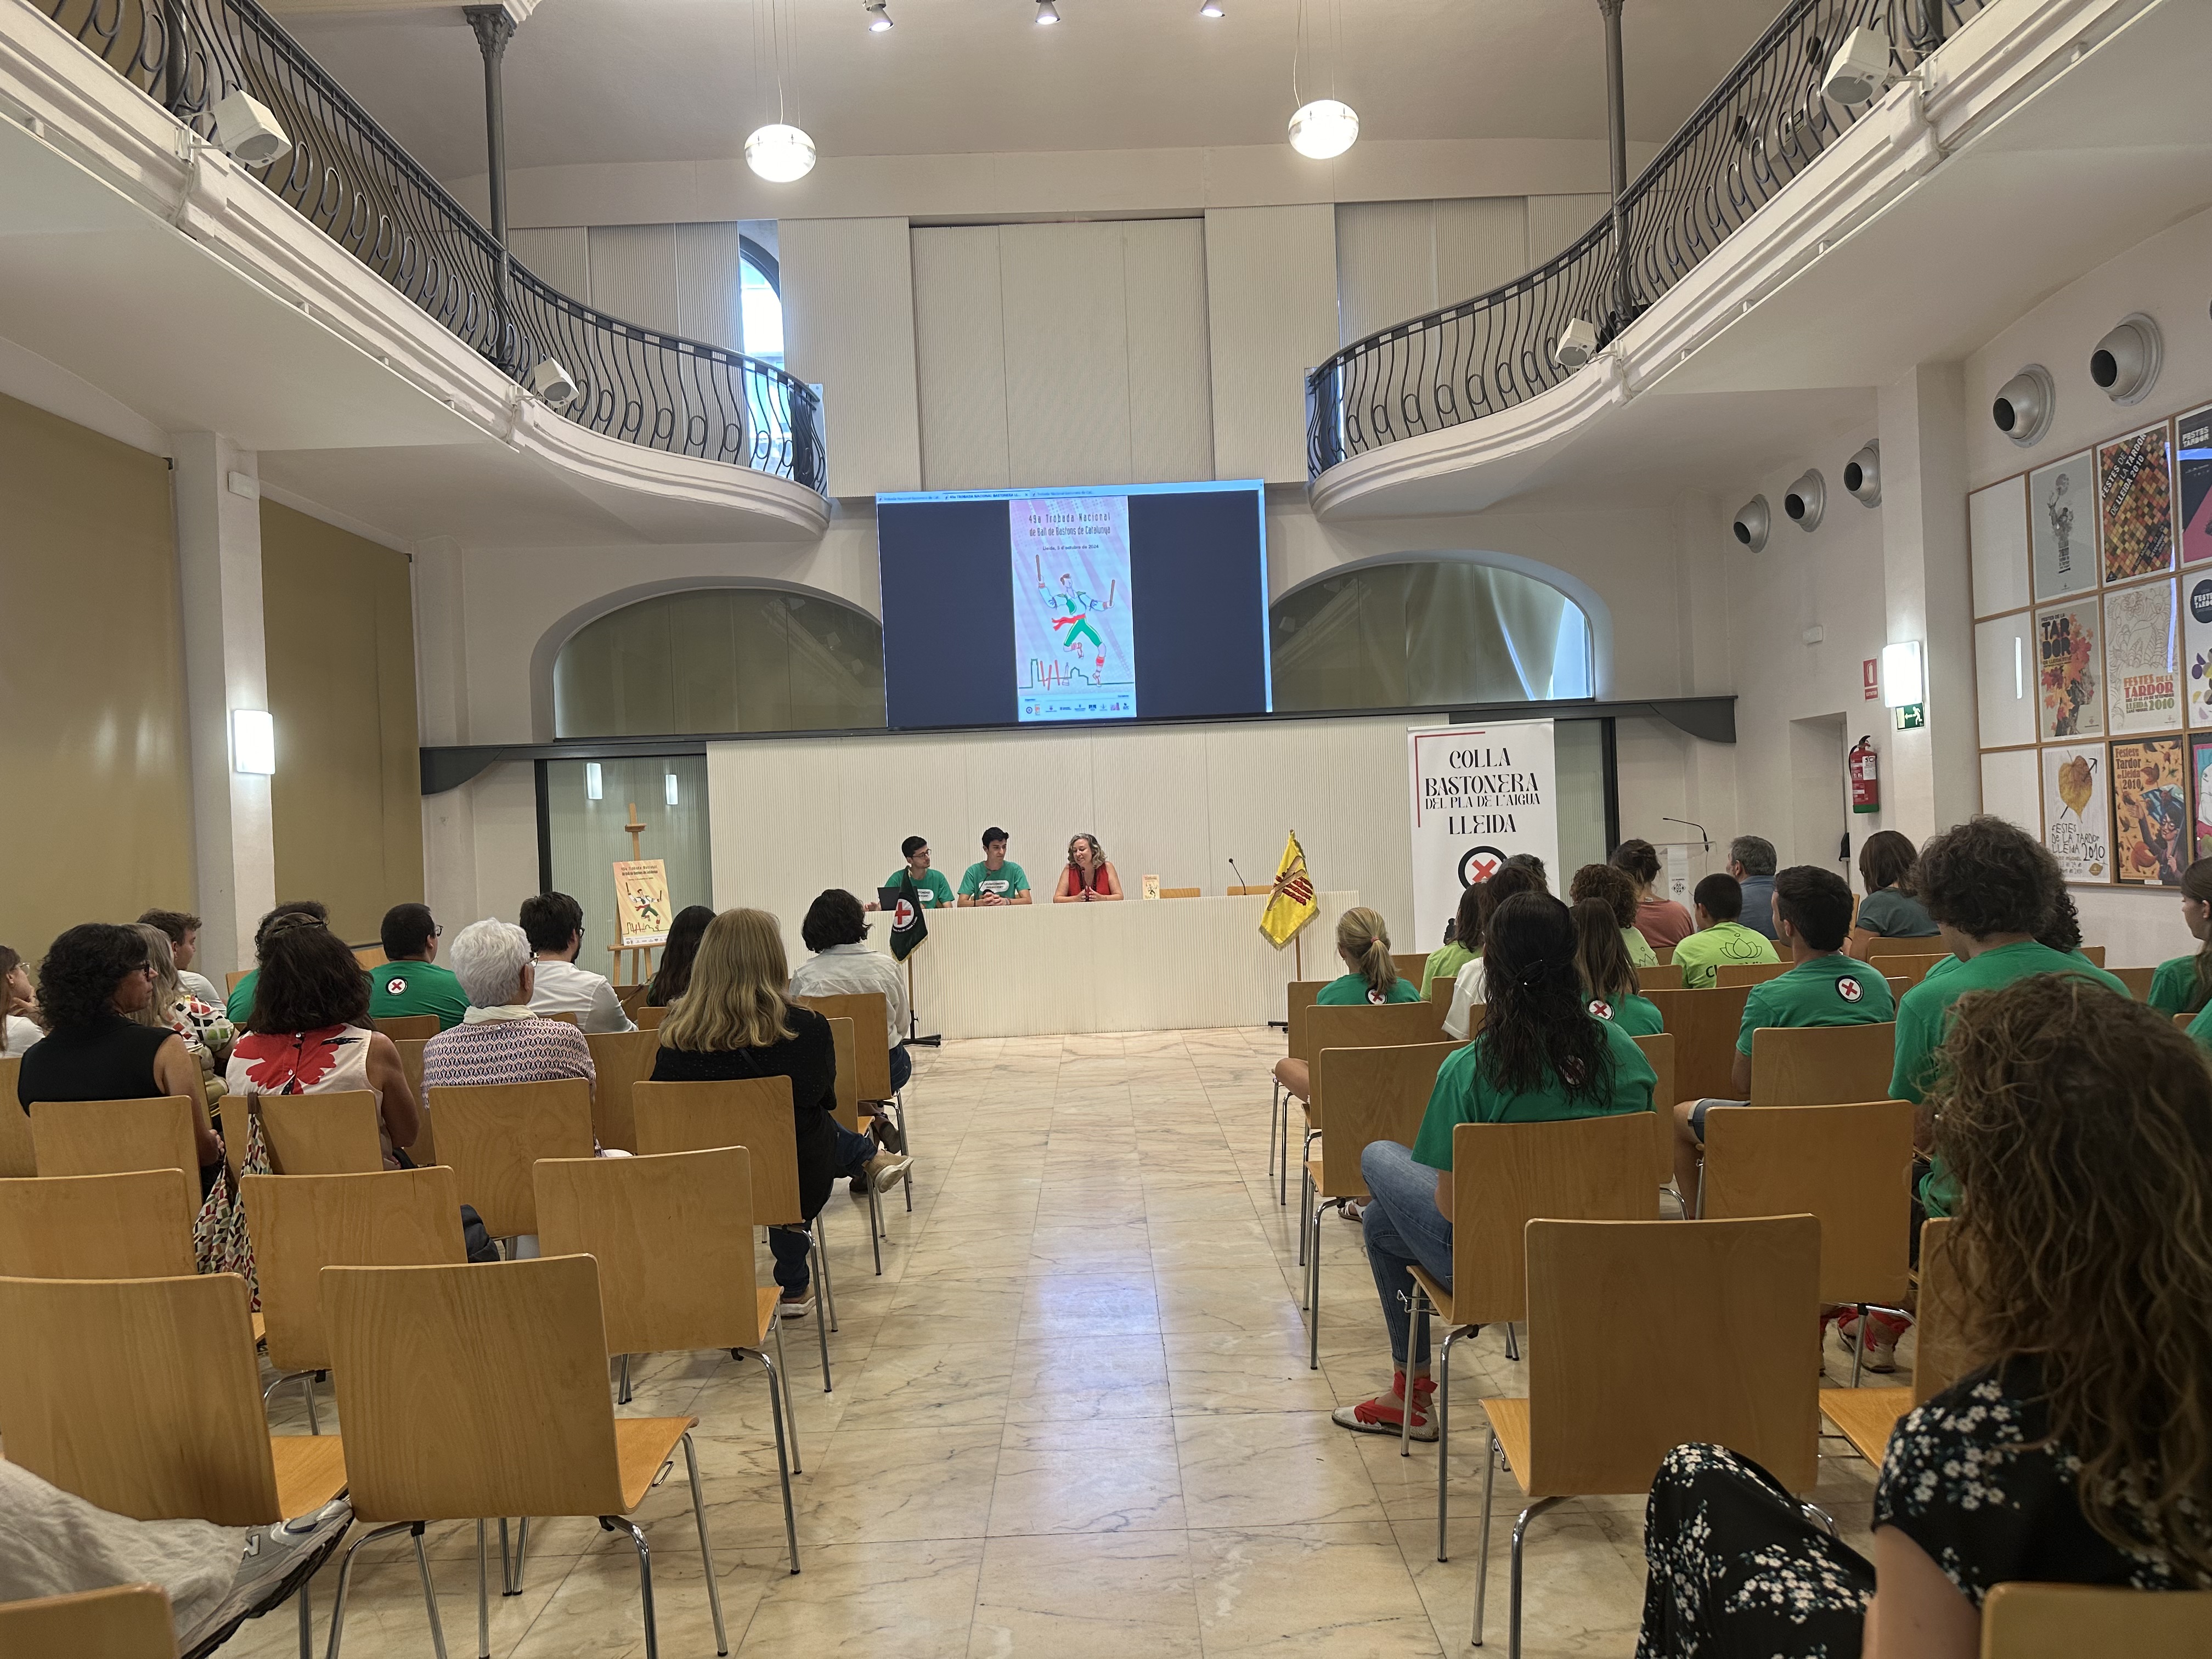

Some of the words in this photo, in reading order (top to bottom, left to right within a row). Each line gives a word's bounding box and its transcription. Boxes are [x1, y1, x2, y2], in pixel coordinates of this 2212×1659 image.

[2182, 426, 2208, 442] FESTES
[2182, 433, 2209, 448] TARDOR
[2120, 469, 2129, 479] LA
[2125, 434, 2147, 466] TARDOR
[2102, 465, 2120, 498] FESTES
[2118, 452, 2127, 465] DE
[2110, 504, 2119, 516] DE
[2116, 478, 2132, 505] LLEIDA
[2130, 455, 2145, 478] 2010
[1029, 515, 1041, 523] 49a
[1046, 514, 1074, 523] Trobada
[1079, 512, 1110, 522] Nacional
[1037, 527, 1046, 536] Ball
[1048, 527, 1054, 535] de
[1056, 526, 1076, 535] Bastons
[1078, 526, 1084, 534] de
[1085, 526, 1110, 535] Catalunya
[2041, 618, 2070, 640] TAR
[2042, 637, 2071, 659] DOR
[2124, 674, 2154, 687] FESTES
[2124, 682, 2174, 698] TARDOR
[2149, 698, 2174, 710] 2010
[1449, 748, 1511, 769] COLLA
[2115, 747, 2135, 758] Festes
[2115, 758, 2141, 769] Tardor
[2122, 769, 2140, 778] Lleida
[1425, 772, 1538, 797] BASTONERA
[2123, 778, 2141, 789] 2010
[1426, 797, 1447, 810] DEL
[1451, 796, 1473, 808] PLA
[1477, 795, 1492, 807] DE
[1496, 793, 1540, 806] L'AIGUA
[1449, 814, 1516, 834] LLEIDA
[2062, 833, 2073, 843] LA
[2081, 843, 2105, 861] 2010
